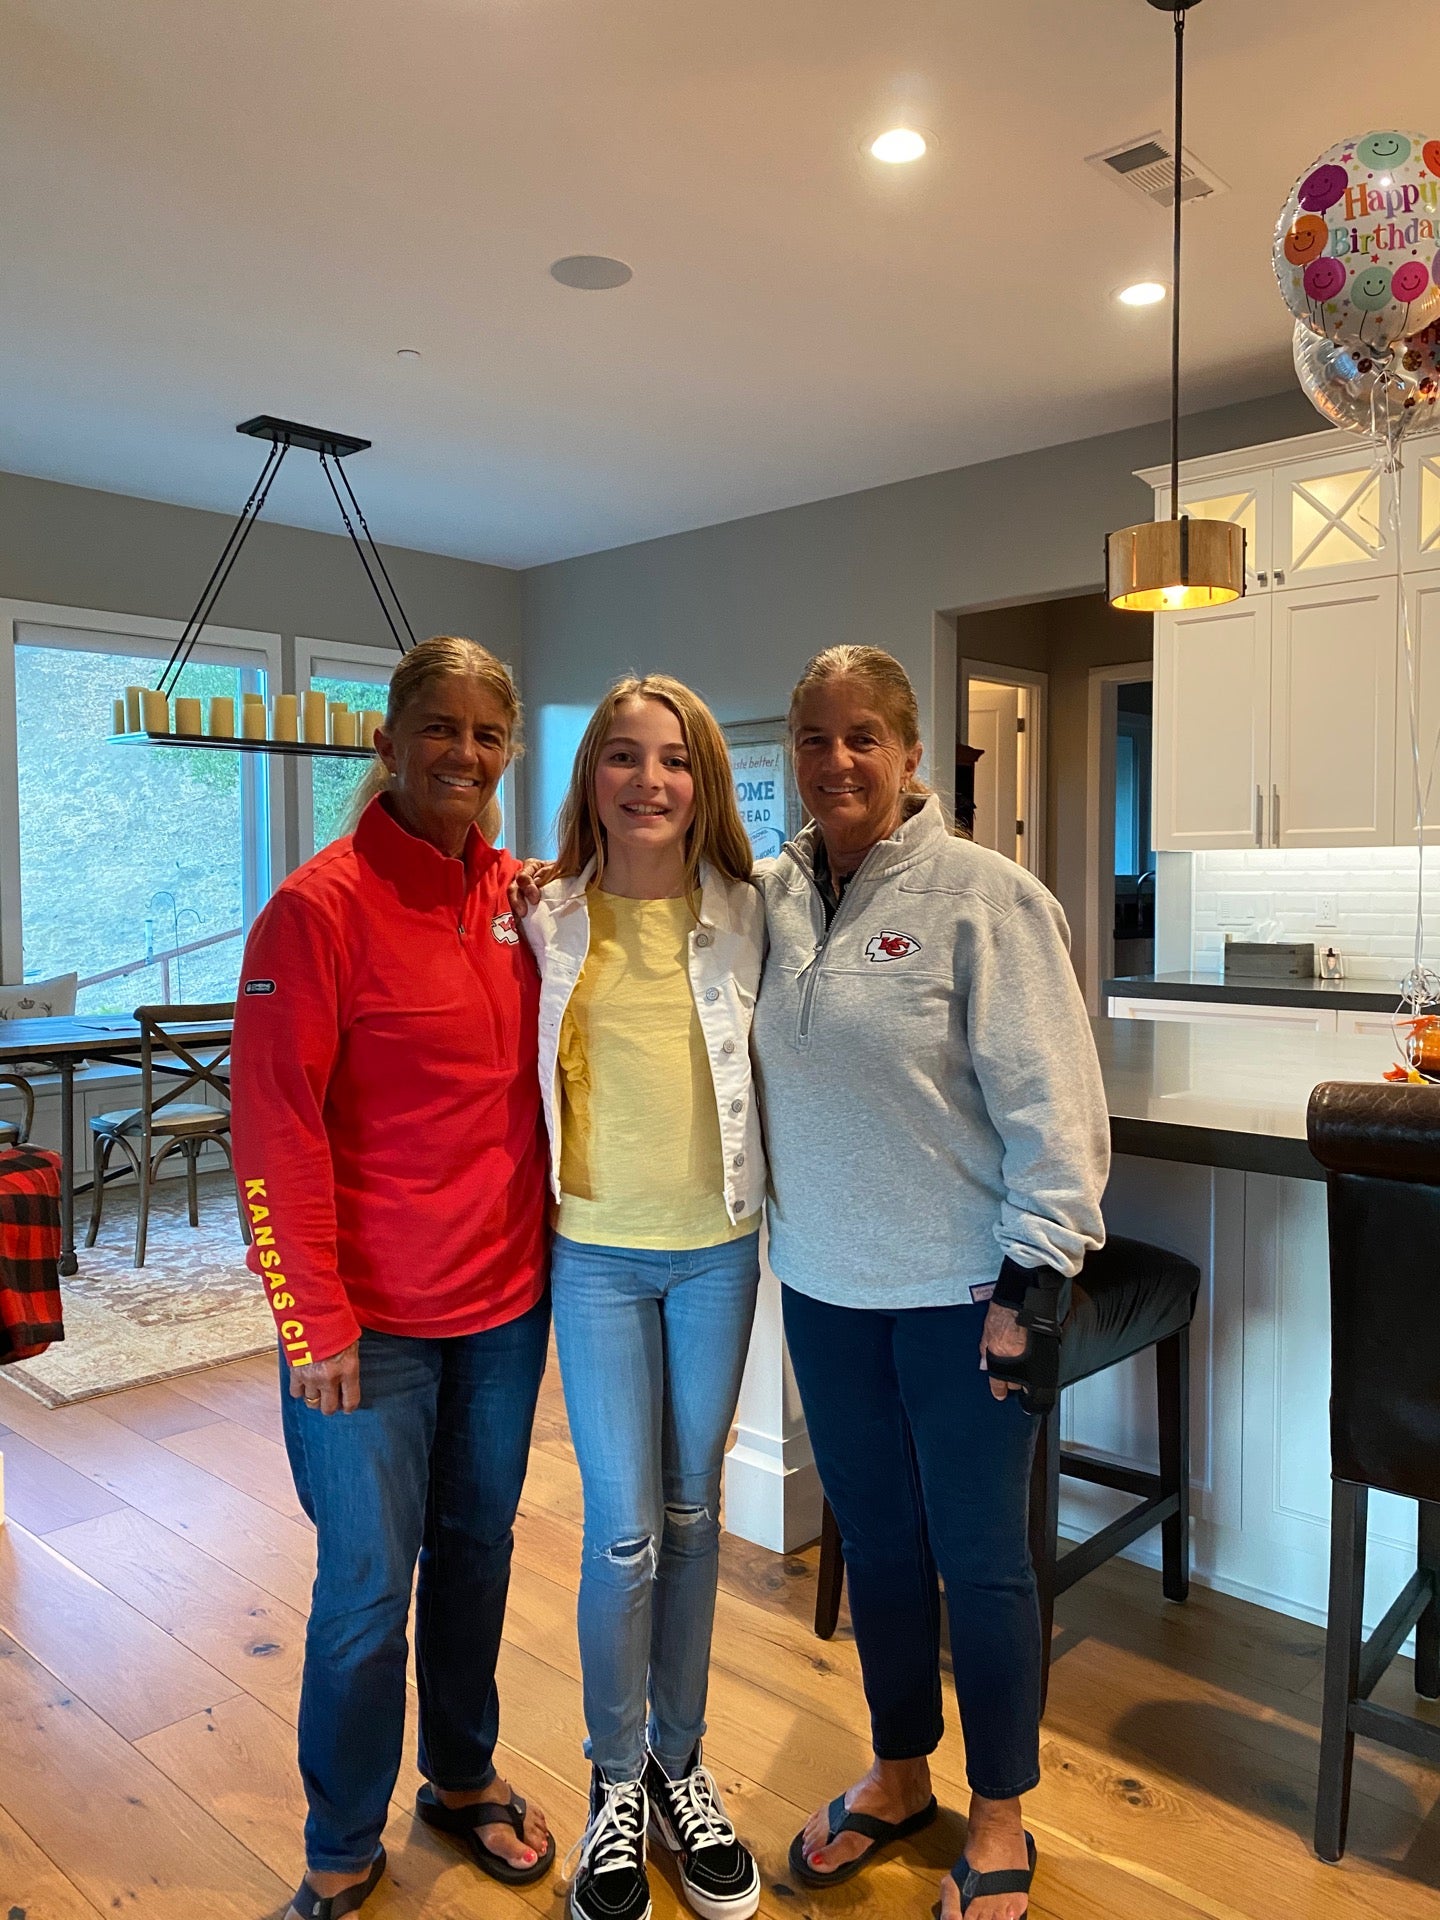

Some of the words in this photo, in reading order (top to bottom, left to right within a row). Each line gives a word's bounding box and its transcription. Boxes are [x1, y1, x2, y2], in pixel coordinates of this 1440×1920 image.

[1343, 181, 1438, 221] Happy
[735, 781, 774, 801] OME
[739, 809, 770, 823] READ
[245, 1179, 295, 1310] KANSAS
[281, 1320, 313, 1367] CIT
